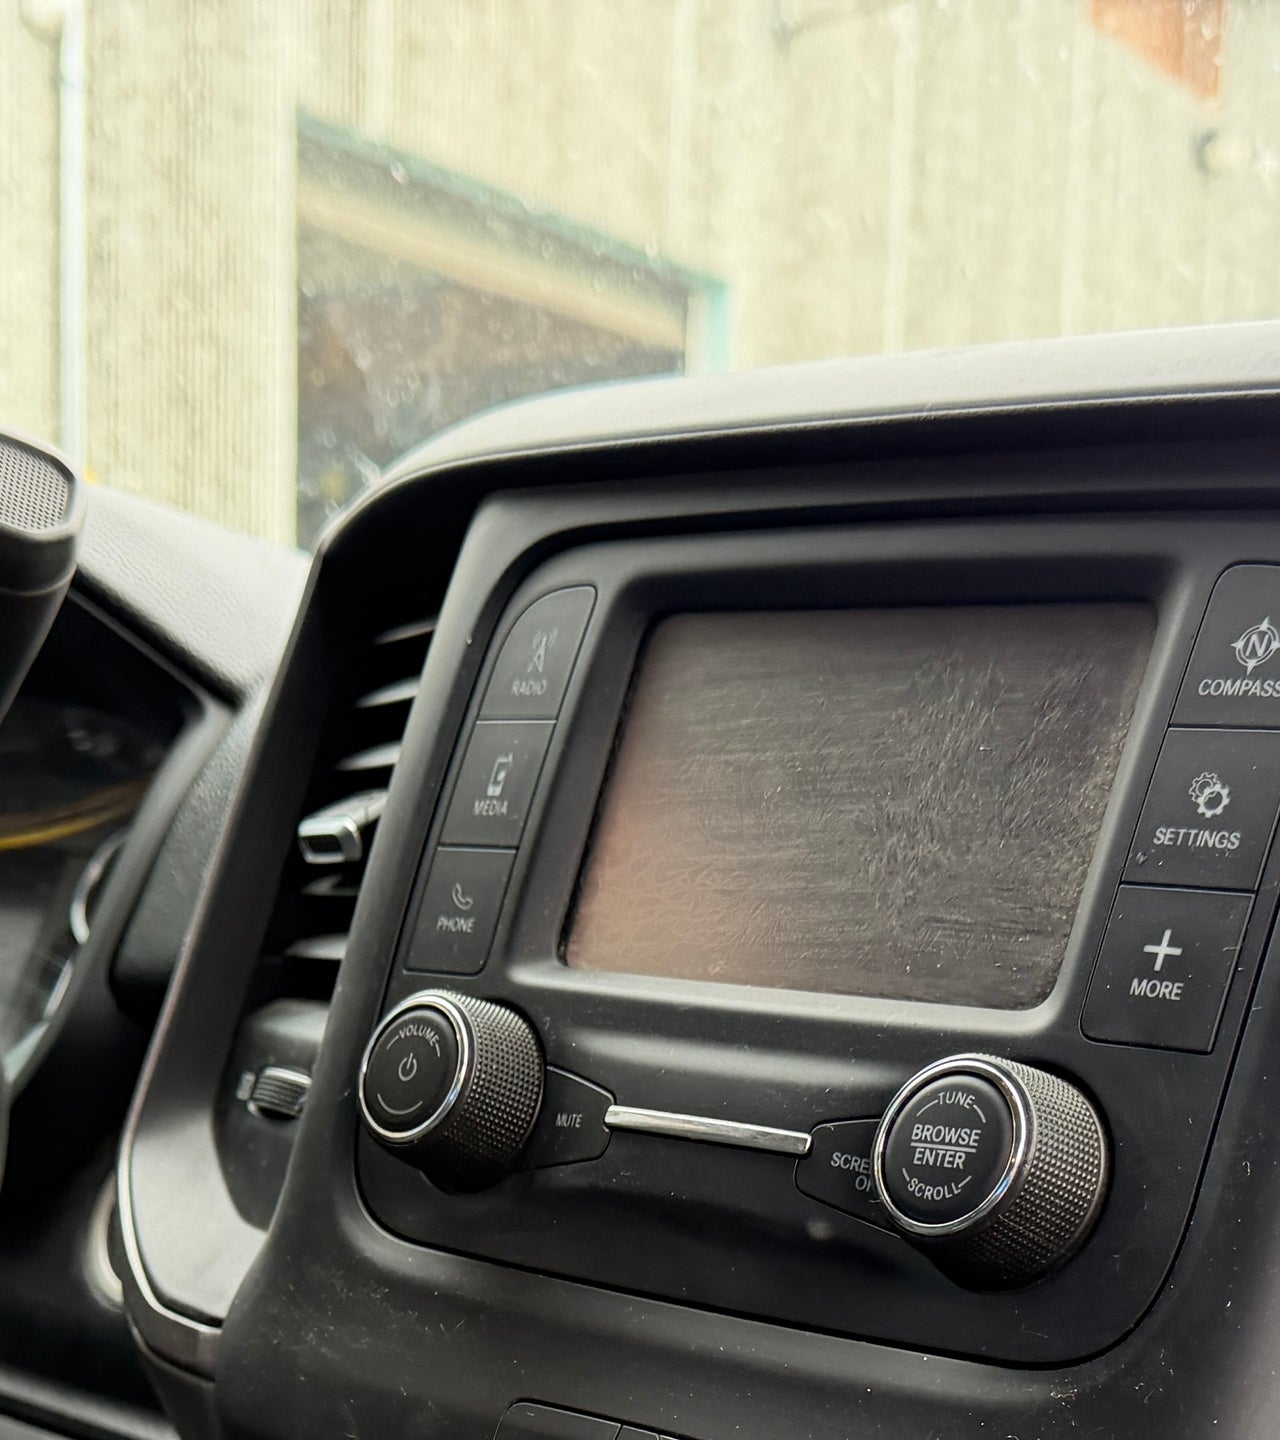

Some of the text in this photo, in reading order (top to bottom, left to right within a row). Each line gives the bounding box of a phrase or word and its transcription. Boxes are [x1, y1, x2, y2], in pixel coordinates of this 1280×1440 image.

[512, 680, 547, 696] RADIO
[473, 799, 508, 816] MEDIA
[1153, 827, 1241, 850] SETTINGS
[436, 916, 476, 934] PHONE
[1129, 978, 1184, 1001] MORE
[398, 1023, 440, 1049] VOLUME
[937, 1091, 976, 1109] TUNE
[555, 1112, 583, 1129] MUTE
[911, 1123, 982, 1147] BROWSE
[830, 1151, 870, 1174] SCRE
[913, 1147, 966, 1170] ENTER
[906, 1177, 961, 1201] SCROLL
